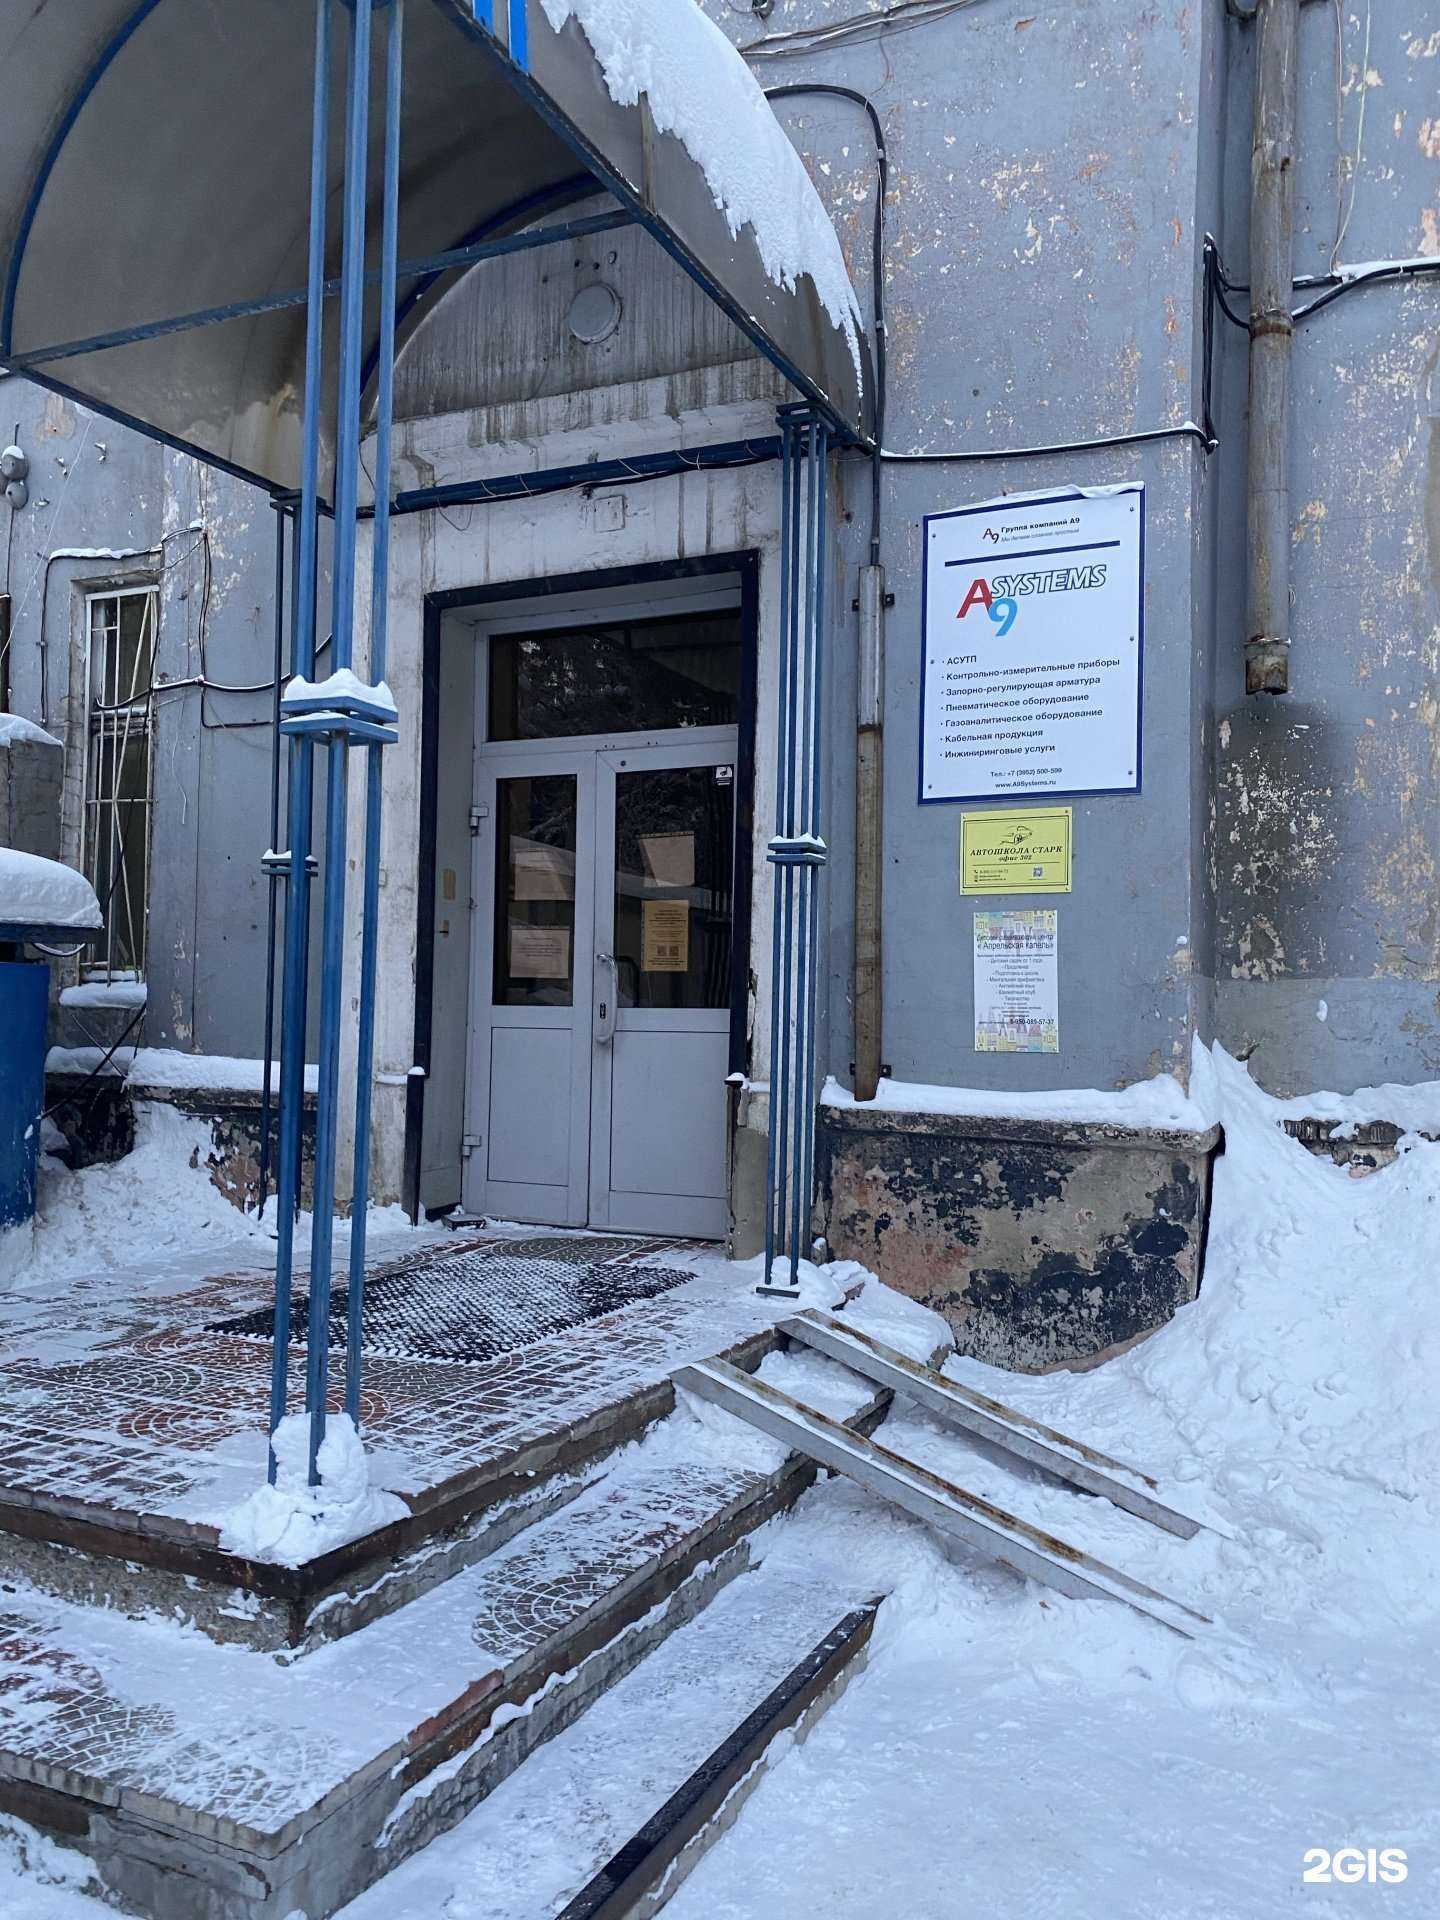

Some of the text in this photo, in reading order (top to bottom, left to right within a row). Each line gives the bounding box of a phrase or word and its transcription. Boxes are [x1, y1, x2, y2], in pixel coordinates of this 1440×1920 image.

[1001, 524, 1028, 533] Группа
[1029, 519, 1068, 530] компаний
[946, 655, 977, 665] АСУТП
[946, 659, 1120, 681] Контрольно-измерительные приборы
[946, 676, 1101, 696] Запорно-регулирующая арматура
[945, 694, 1089, 712] Пневматическое оборудование
[945, 709, 1103, 727] Газоаналитическое оборудование
[945, 729, 1043, 743] Кабельная продукция
[945, 744, 1056, 758] Инжиниринговые услуги
[970, 846, 1064, 857] АВТОШКОЛА СТАРК
